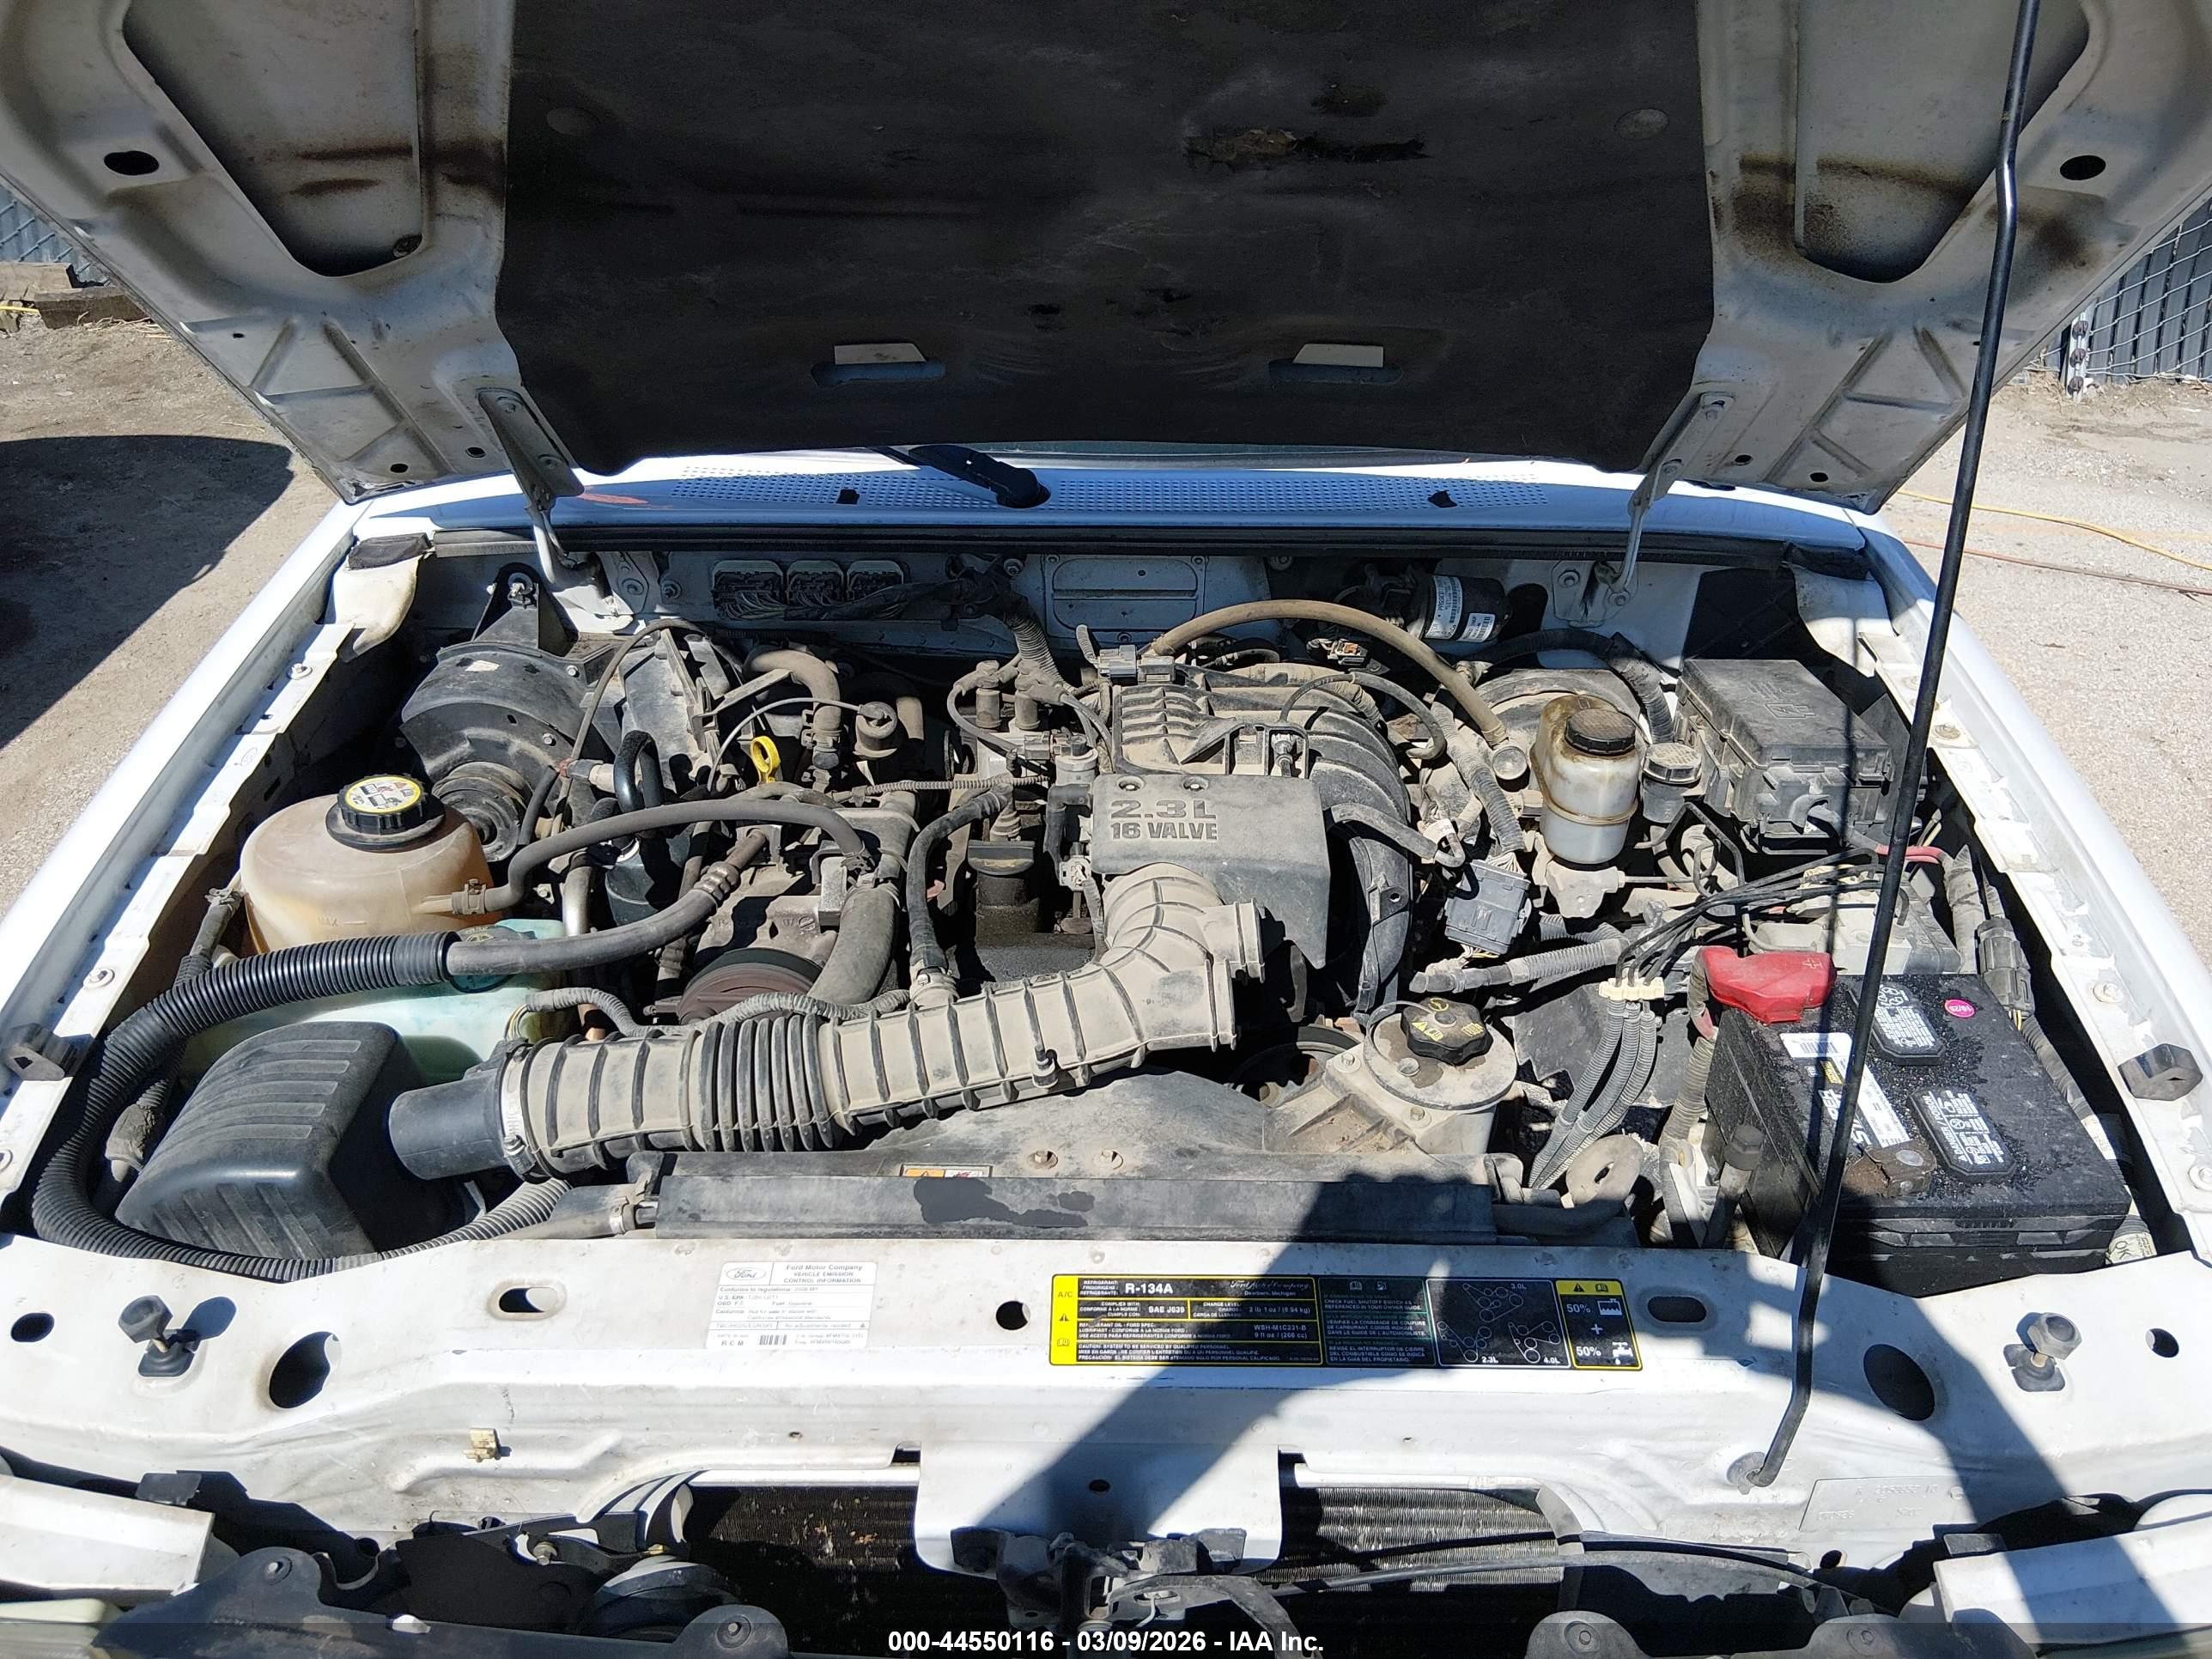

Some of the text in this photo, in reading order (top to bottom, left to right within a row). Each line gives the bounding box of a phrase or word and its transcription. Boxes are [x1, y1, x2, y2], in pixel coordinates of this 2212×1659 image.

[1111, 799, 1217, 818] 2.3L
[1111, 823, 1218, 840] 16 VALVE
[1922, 1095, 1943, 1121] POISON
[1941, 1126, 1963, 1155] DANGER
[734, 1269, 757, 1279] Ford
[1125, 1283, 1173, 1294] R-134A
[1566, 1304, 1590, 1313] 50%
[1576, 1346, 1601, 1357] 50%
